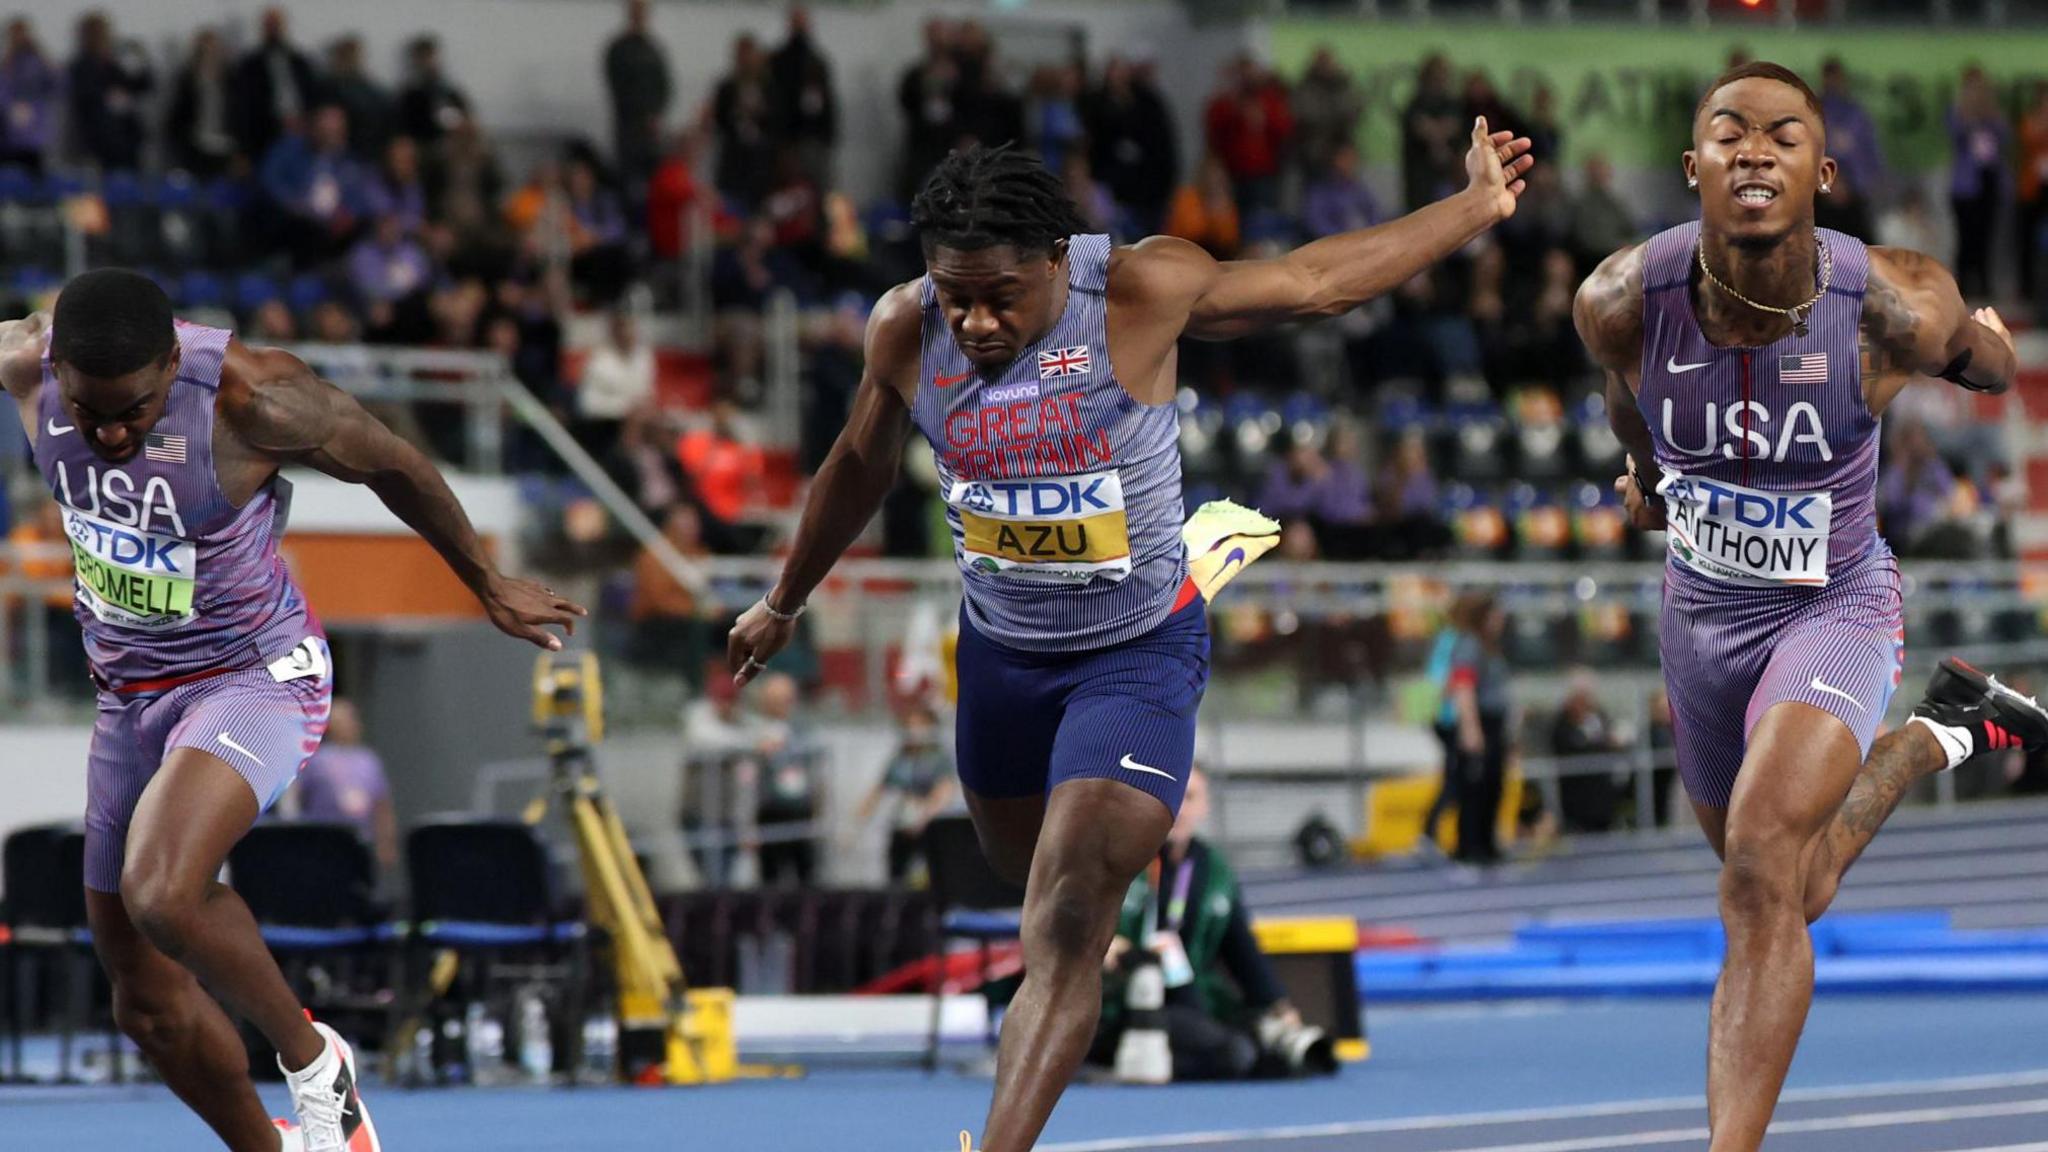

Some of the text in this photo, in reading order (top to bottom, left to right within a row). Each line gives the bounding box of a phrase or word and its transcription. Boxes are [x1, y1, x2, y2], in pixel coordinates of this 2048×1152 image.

[983, 385, 1039, 401] Novuna
[944, 391, 1085, 449] GREAT
[1662, 397, 1833, 463] USA
[944, 428, 1112, 480] BRITAIN
[57, 460, 186, 537] USA
[992, 478, 1110, 516] TDK
[1697, 481, 1817, 529] TDK
[86, 520, 182, 573] TDK
[996, 523, 1088, 557] AZU
[1675, 500, 1819, 572] ANTHONY
[78, 548, 181, 615] BROMELL
